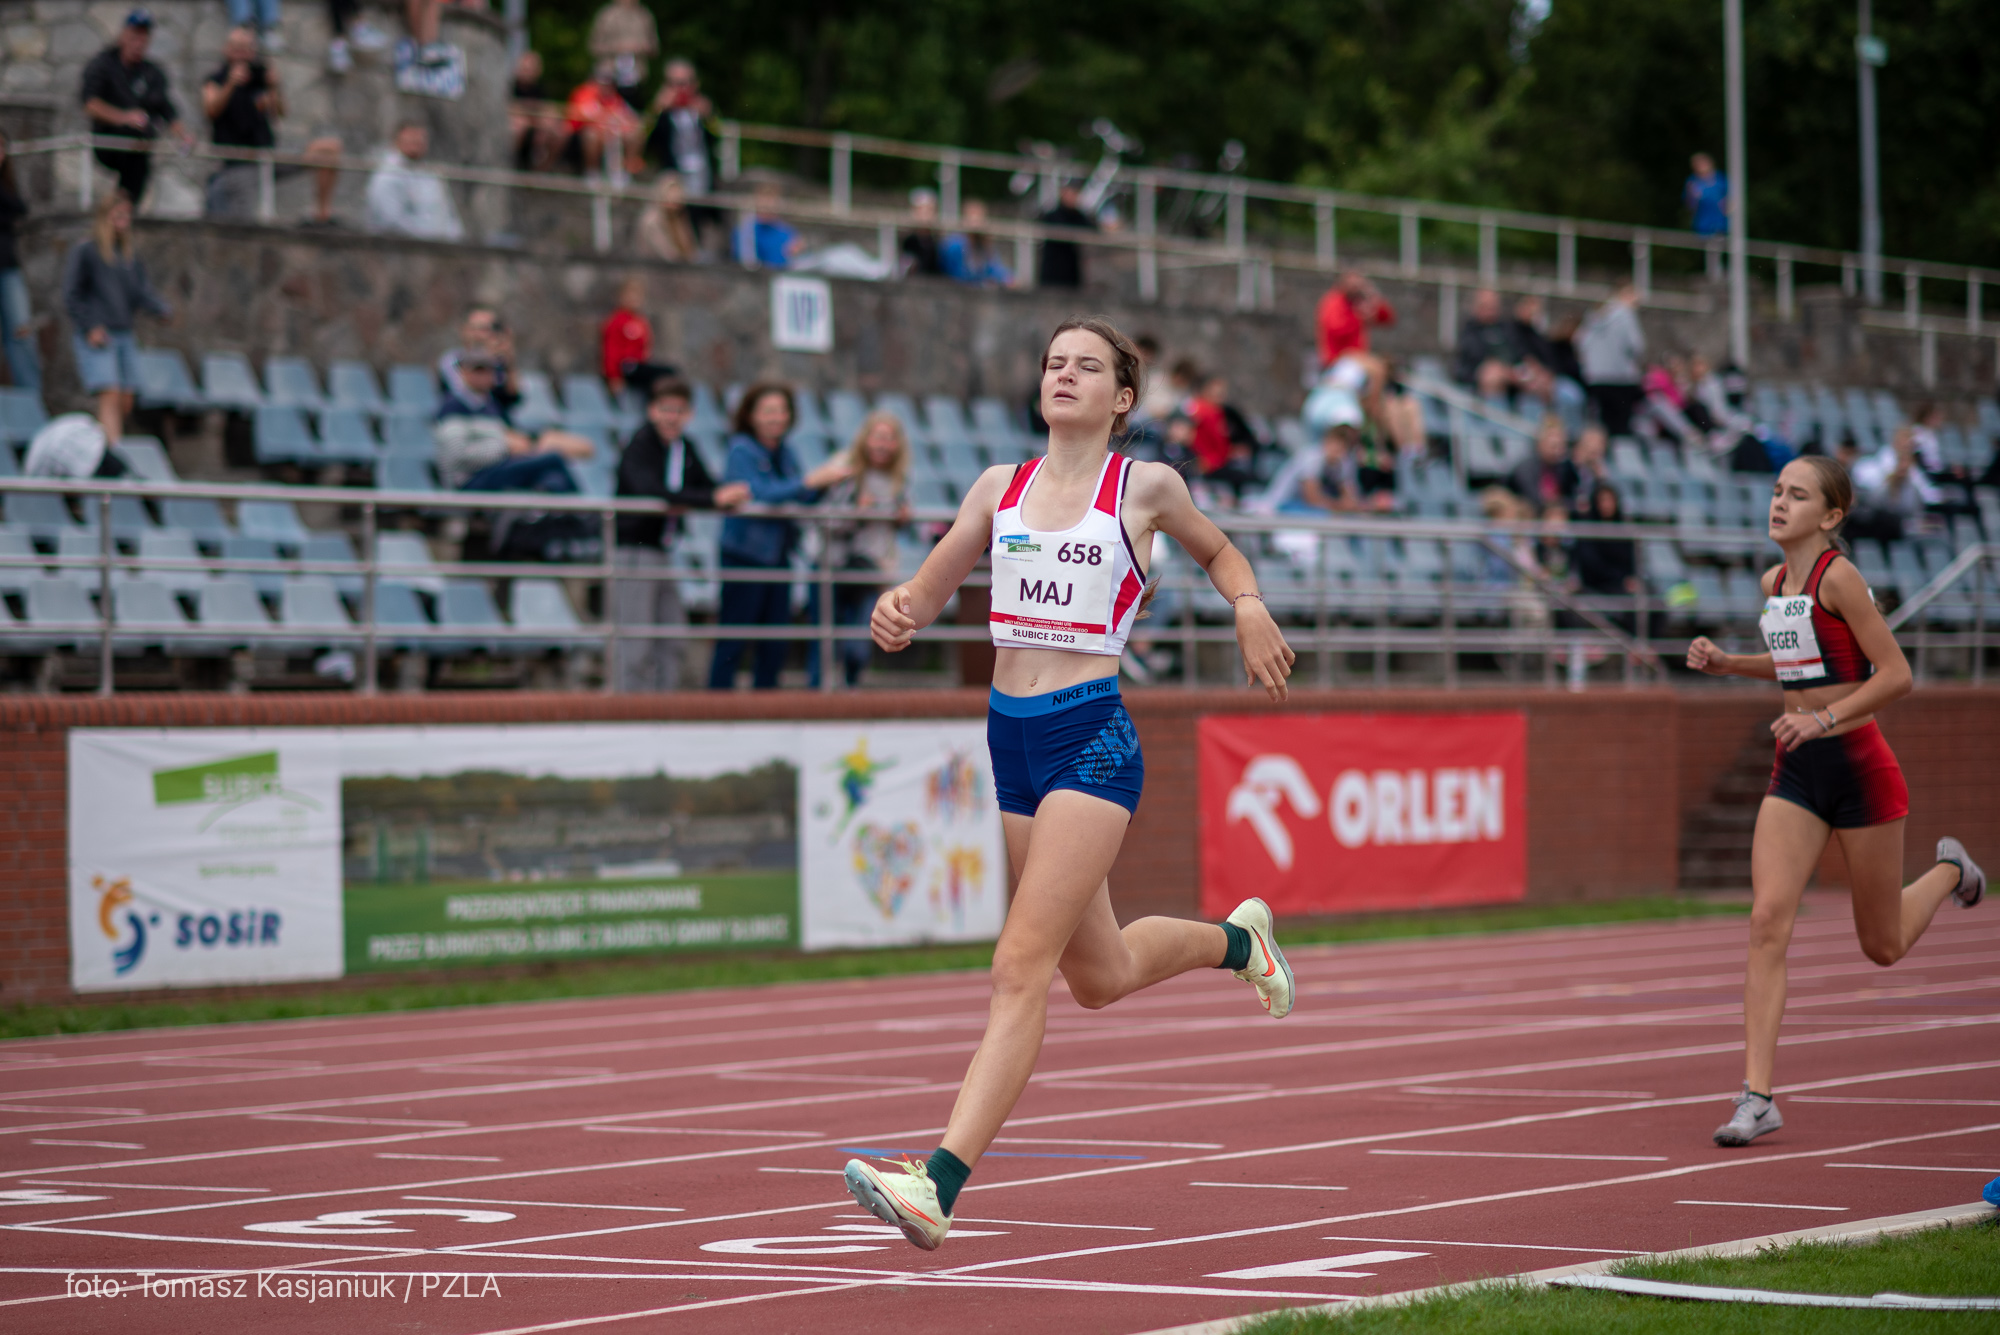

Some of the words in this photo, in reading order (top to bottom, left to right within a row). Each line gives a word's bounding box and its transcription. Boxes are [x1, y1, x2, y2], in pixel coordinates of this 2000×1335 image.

[1057, 542, 1102, 566] 658
[1019, 577, 1073, 606] MAJ
[1784, 600, 1806, 617] 858
[1012, 628, 1049, 641] SŁUBICE
[1050, 633, 1075, 643] 2023
[1052, 687, 1084, 706] NIKE
[1087, 681, 1111, 695] PRO
[1329, 766, 1504, 848] ORLEN
